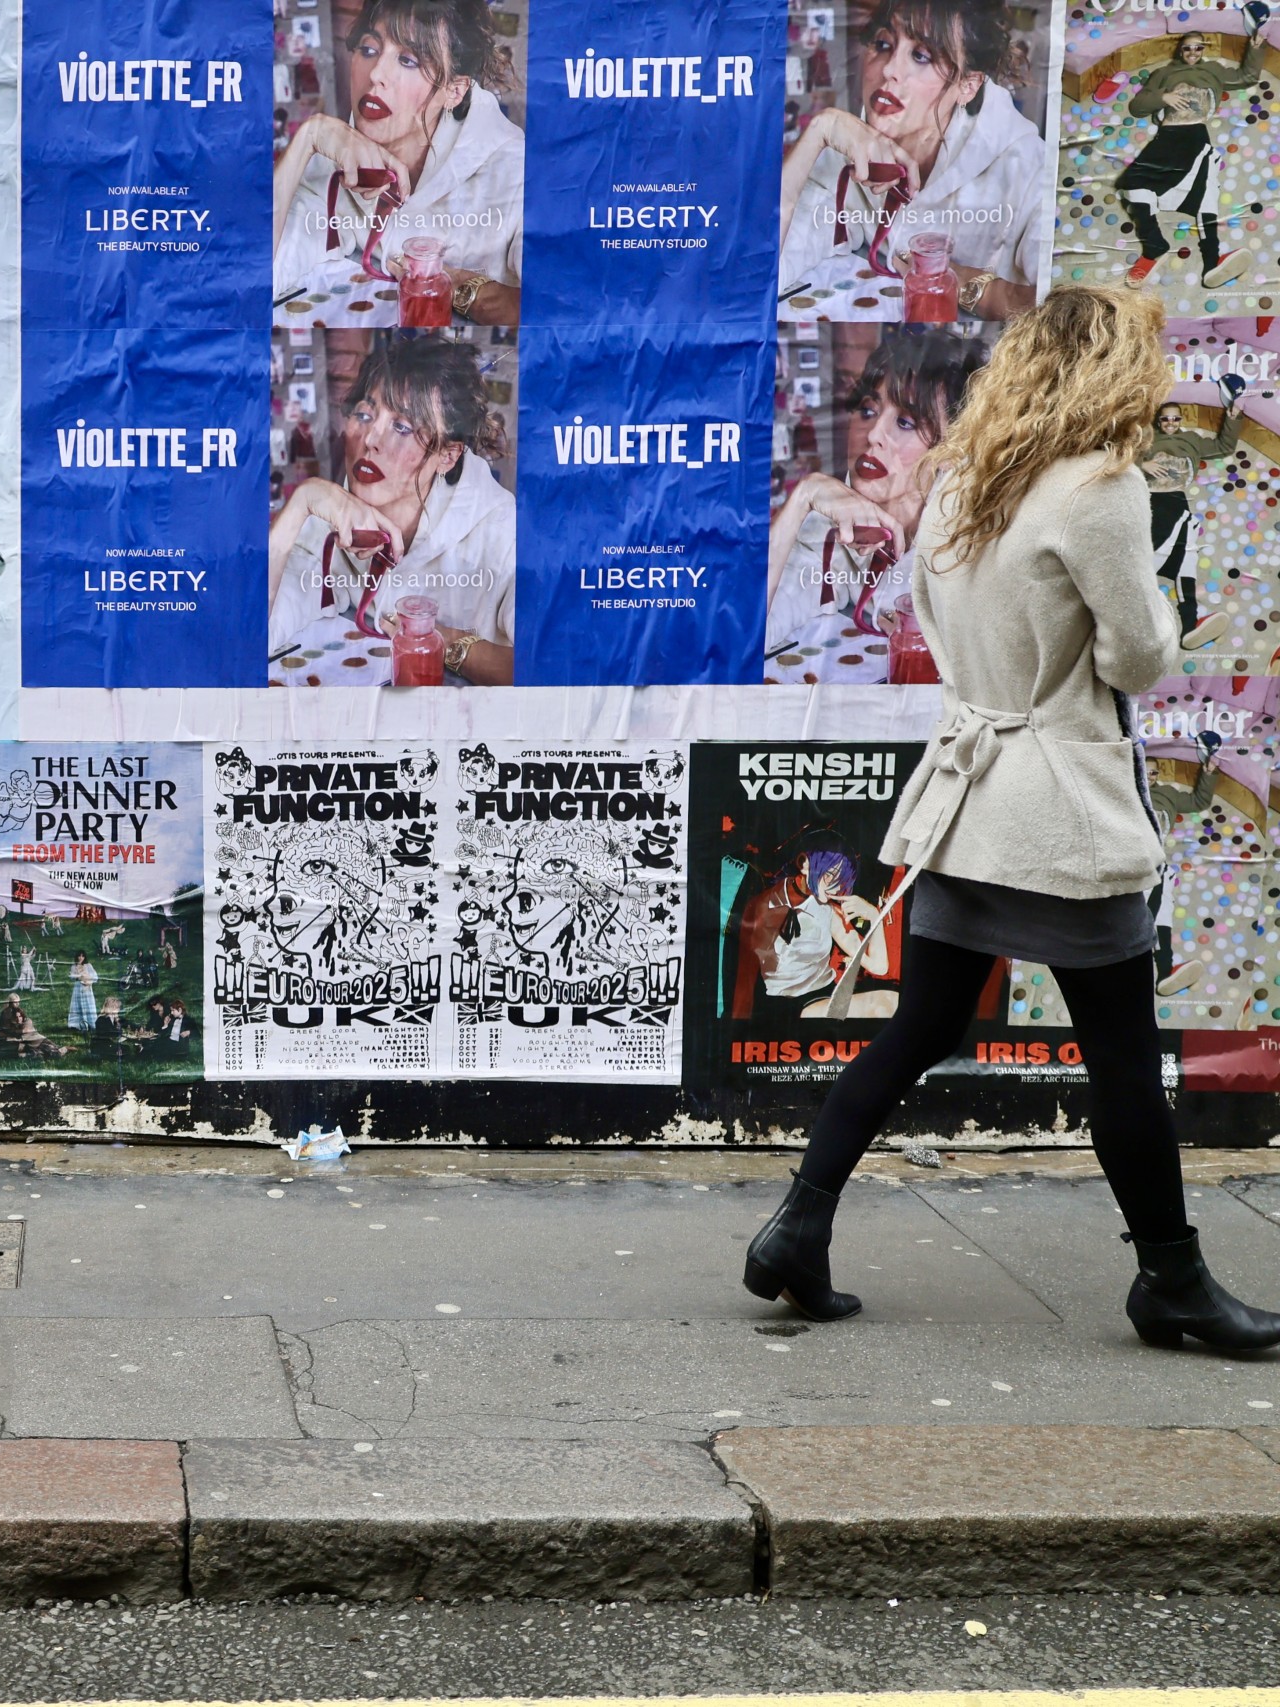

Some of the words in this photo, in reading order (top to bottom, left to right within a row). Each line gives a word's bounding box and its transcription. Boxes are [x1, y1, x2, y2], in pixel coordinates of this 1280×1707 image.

[108, 186, 130, 195] NOW
[131, 186, 177, 195] AVAILABLE
[178, 187, 189, 195] AT
[612, 184, 635, 193] NOW
[636, 183, 684, 192] AVAILABLE
[685, 183, 697, 192] AT
[394, 209, 410, 229] is
[414, 215, 426, 228] a
[901, 205, 917, 224] is
[923, 212, 936, 224] a
[97, 242, 117, 251] THE
[119, 241, 159, 251] BEAUTY
[160, 242, 200, 252] STUDIO
[600, 240, 621, 249] THE
[623, 240, 665, 249] BEAUTY
[666, 239, 708, 249] STUDIO
[106, 549, 126, 557] NOW
[127, 549, 173, 557] AVAILABLE
[174, 549, 185, 557] AT
[603, 546, 625, 554] NOW
[626, 545, 673, 554] AVAILABLE
[674, 545, 685, 553] AT
[387, 569, 403, 587] is
[407, 575, 420, 587] a
[887, 566, 904, 584] is
[95, 602, 115, 611] THE
[117, 602, 157, 611] BEAUTY
[158, 602, 196, 611] STUDIO
[591, 600, 612, 608] THE
[614, 599, 655, 608] BEAUTY
[656, 599, 695, 608] STUDIO
[299, 752, 328, 760] TOURS
[543, 750, 572, 758] TOURS
[32, 757, 79, 777] THE
[88, 757, 149, 777] LAST
[739, 753, 896, 777] KENSHI
[255, 763, 398, 792] PRIVATE
[498, 762, 643, 791] PRIVATE
[34, 780, 178, 810] DINNER
[740, 779, 894, 801] YONEZU
[233, 791, 421, 824] FUNCTION
[475, 791, 666, 822] FUNCTION
[35, 812, 148, 842] PARTY
[12, 843, 65, 863] FROM
[70, 844, 104, 864] THE
[108, 845, 155, 864] PYRE
[49, 871, 65, 880] THE
[67, 871, 85, 880] NEW
[87, 872, 118, 881] ALBUM
[64, 881, 81, 889] OUT
[83, 881, 103, 890] NOW
[317, 980, 350, 1005] TOUR
[553, 979, 587, 1005] TOUR
[272, 1006, 391, 1028] UK
[508, 1006, 627, 1028] UK
[732, 1041, 801, 1063] IRIS
[977, 1043, 1050, 1064] IRIS
[1259, 1038, 1280, 1050] Th
[747, 1066, 789, 1074] CHAINSAW
[792, 1066, 810, 1074] MAN
[818, 1065, 835, 1073] THE
[794, 1074, 811, 1082] ARC
